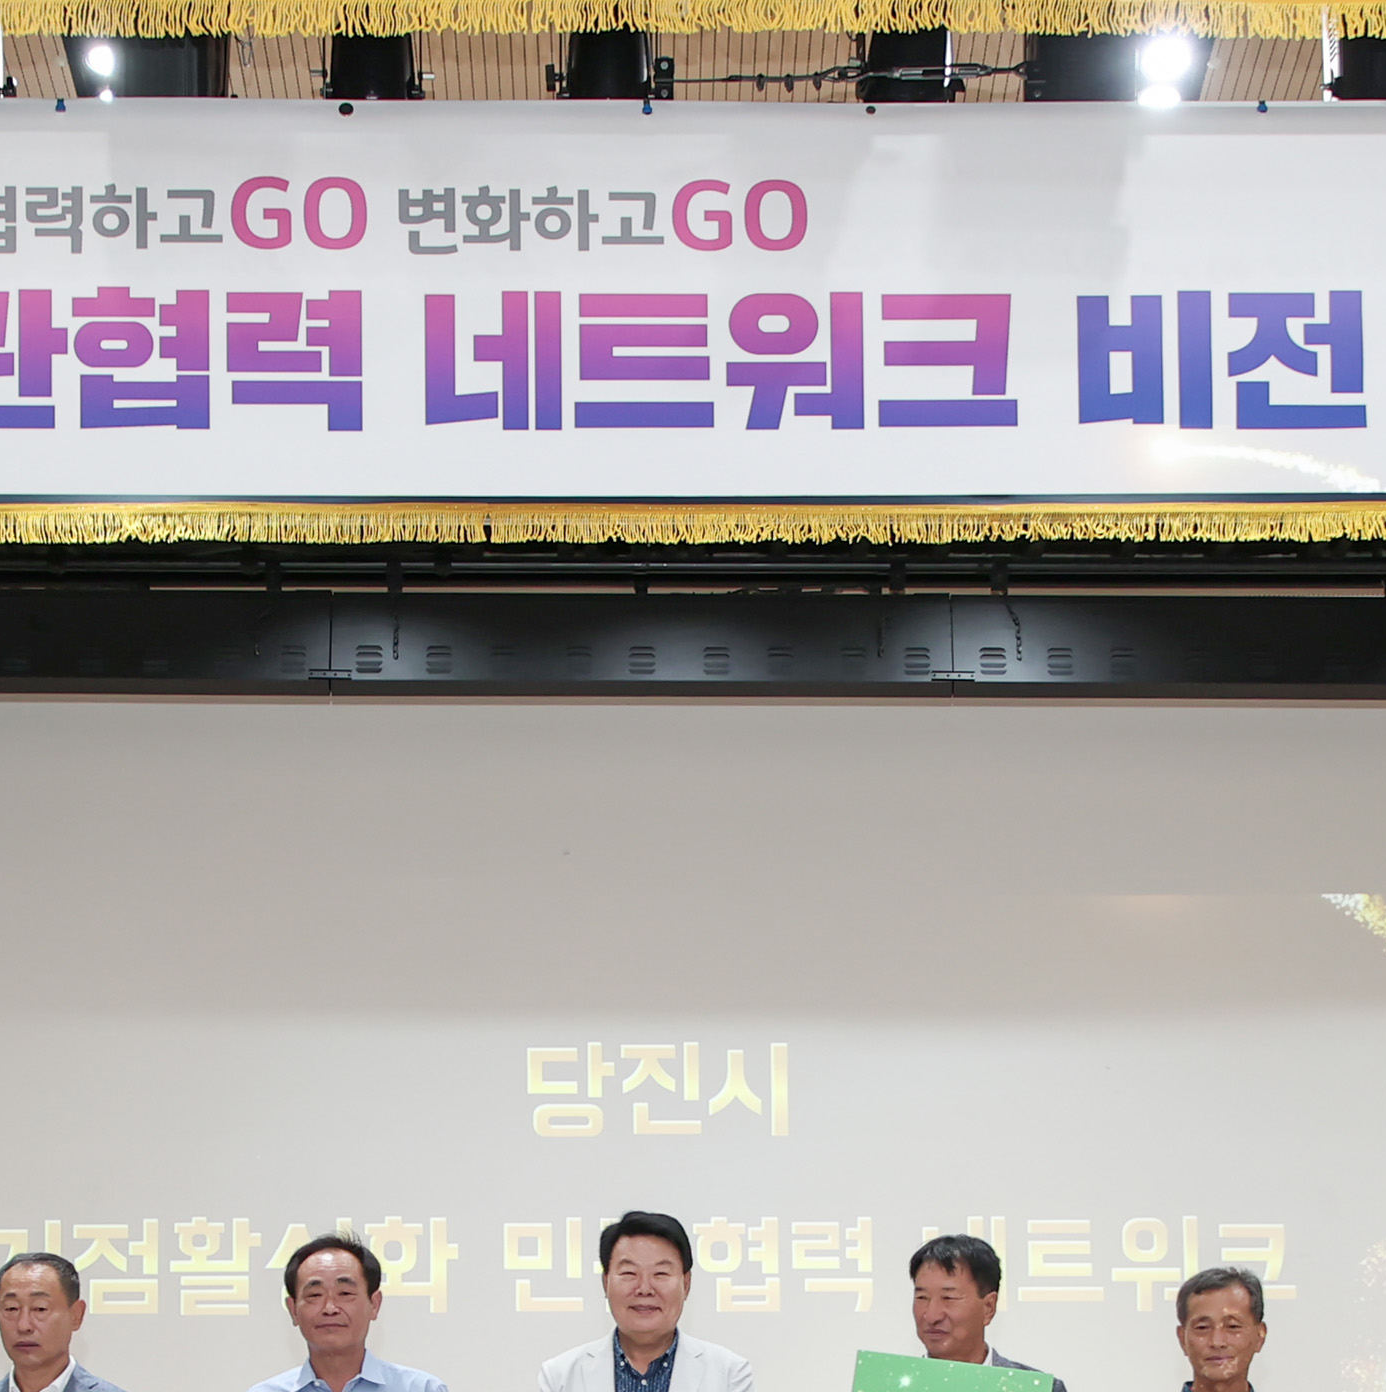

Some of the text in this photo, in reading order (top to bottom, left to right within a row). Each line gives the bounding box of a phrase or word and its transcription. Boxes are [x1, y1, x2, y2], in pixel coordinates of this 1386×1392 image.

[398, 179, 808, 255] 변화하고GO
[424, 290, 1018, 432] 네트워크
[1076, 290, 1368, 430] 비전
[525, 1040, 791, 1138] 당진시
[502, 1215, 874, 1313] 민협력
